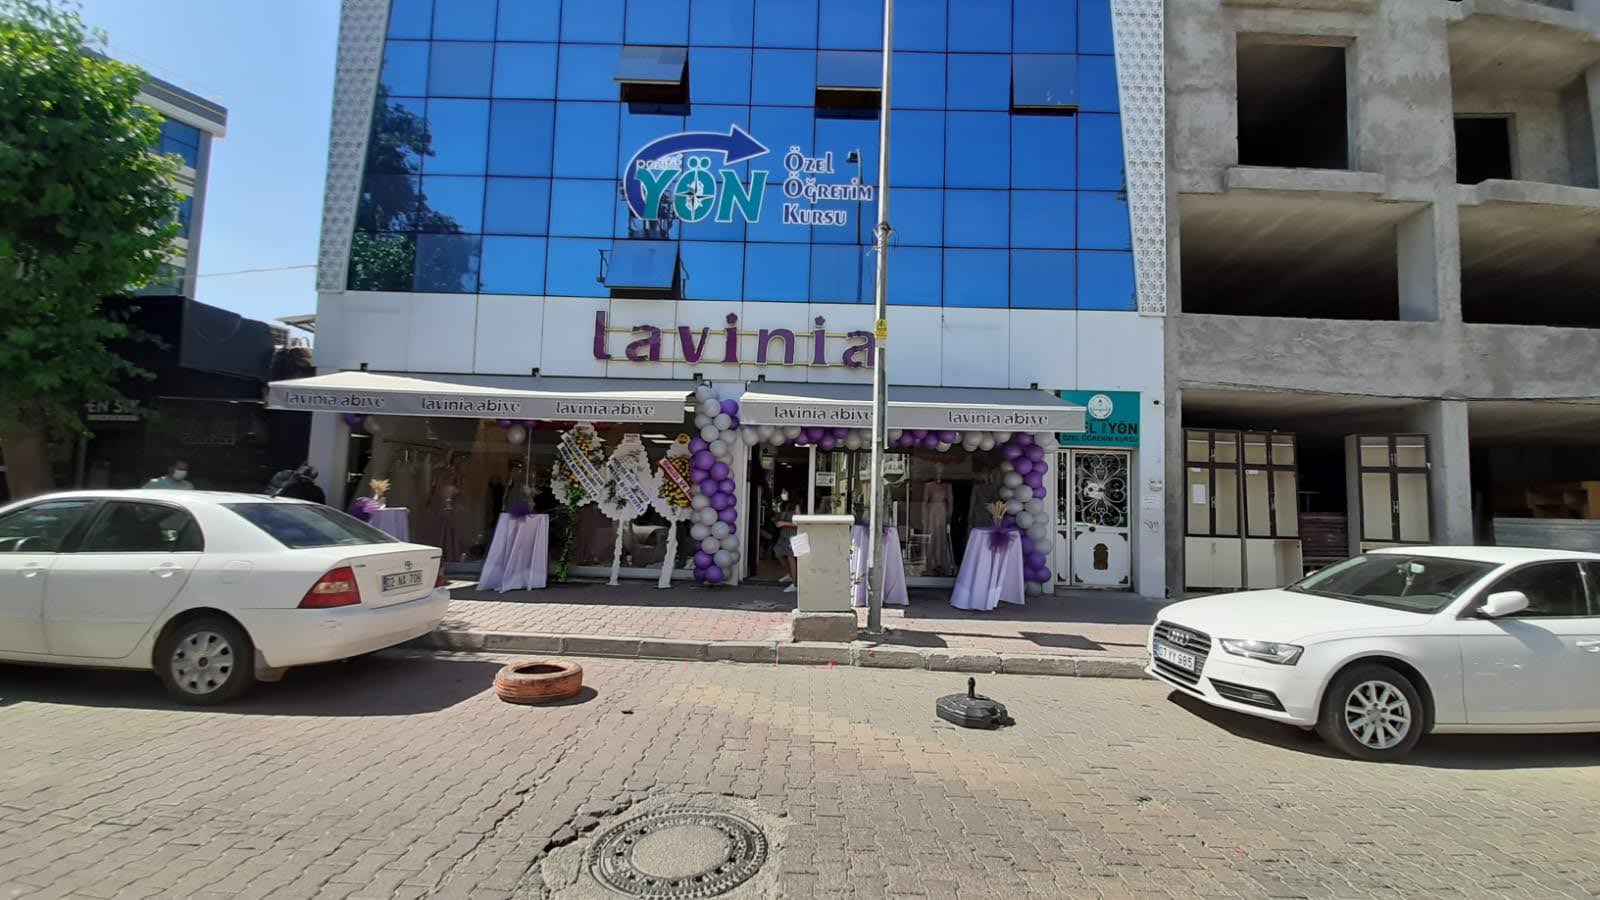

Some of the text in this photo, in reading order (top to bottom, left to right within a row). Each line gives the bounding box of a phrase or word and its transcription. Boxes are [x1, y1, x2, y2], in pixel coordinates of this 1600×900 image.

[635, 156, 769, 223] YÖN
[593, 310, 875, 368] lavinia
[285, 391, 384, 408] lavinia abiye
[421, 397, 521, 414] lavinia abiye
[556, 401, 654, 418] lavinia abiye
[774, 406, 826, 420] lavinia
[948, 411, 1048, 426] lavinia abiye
